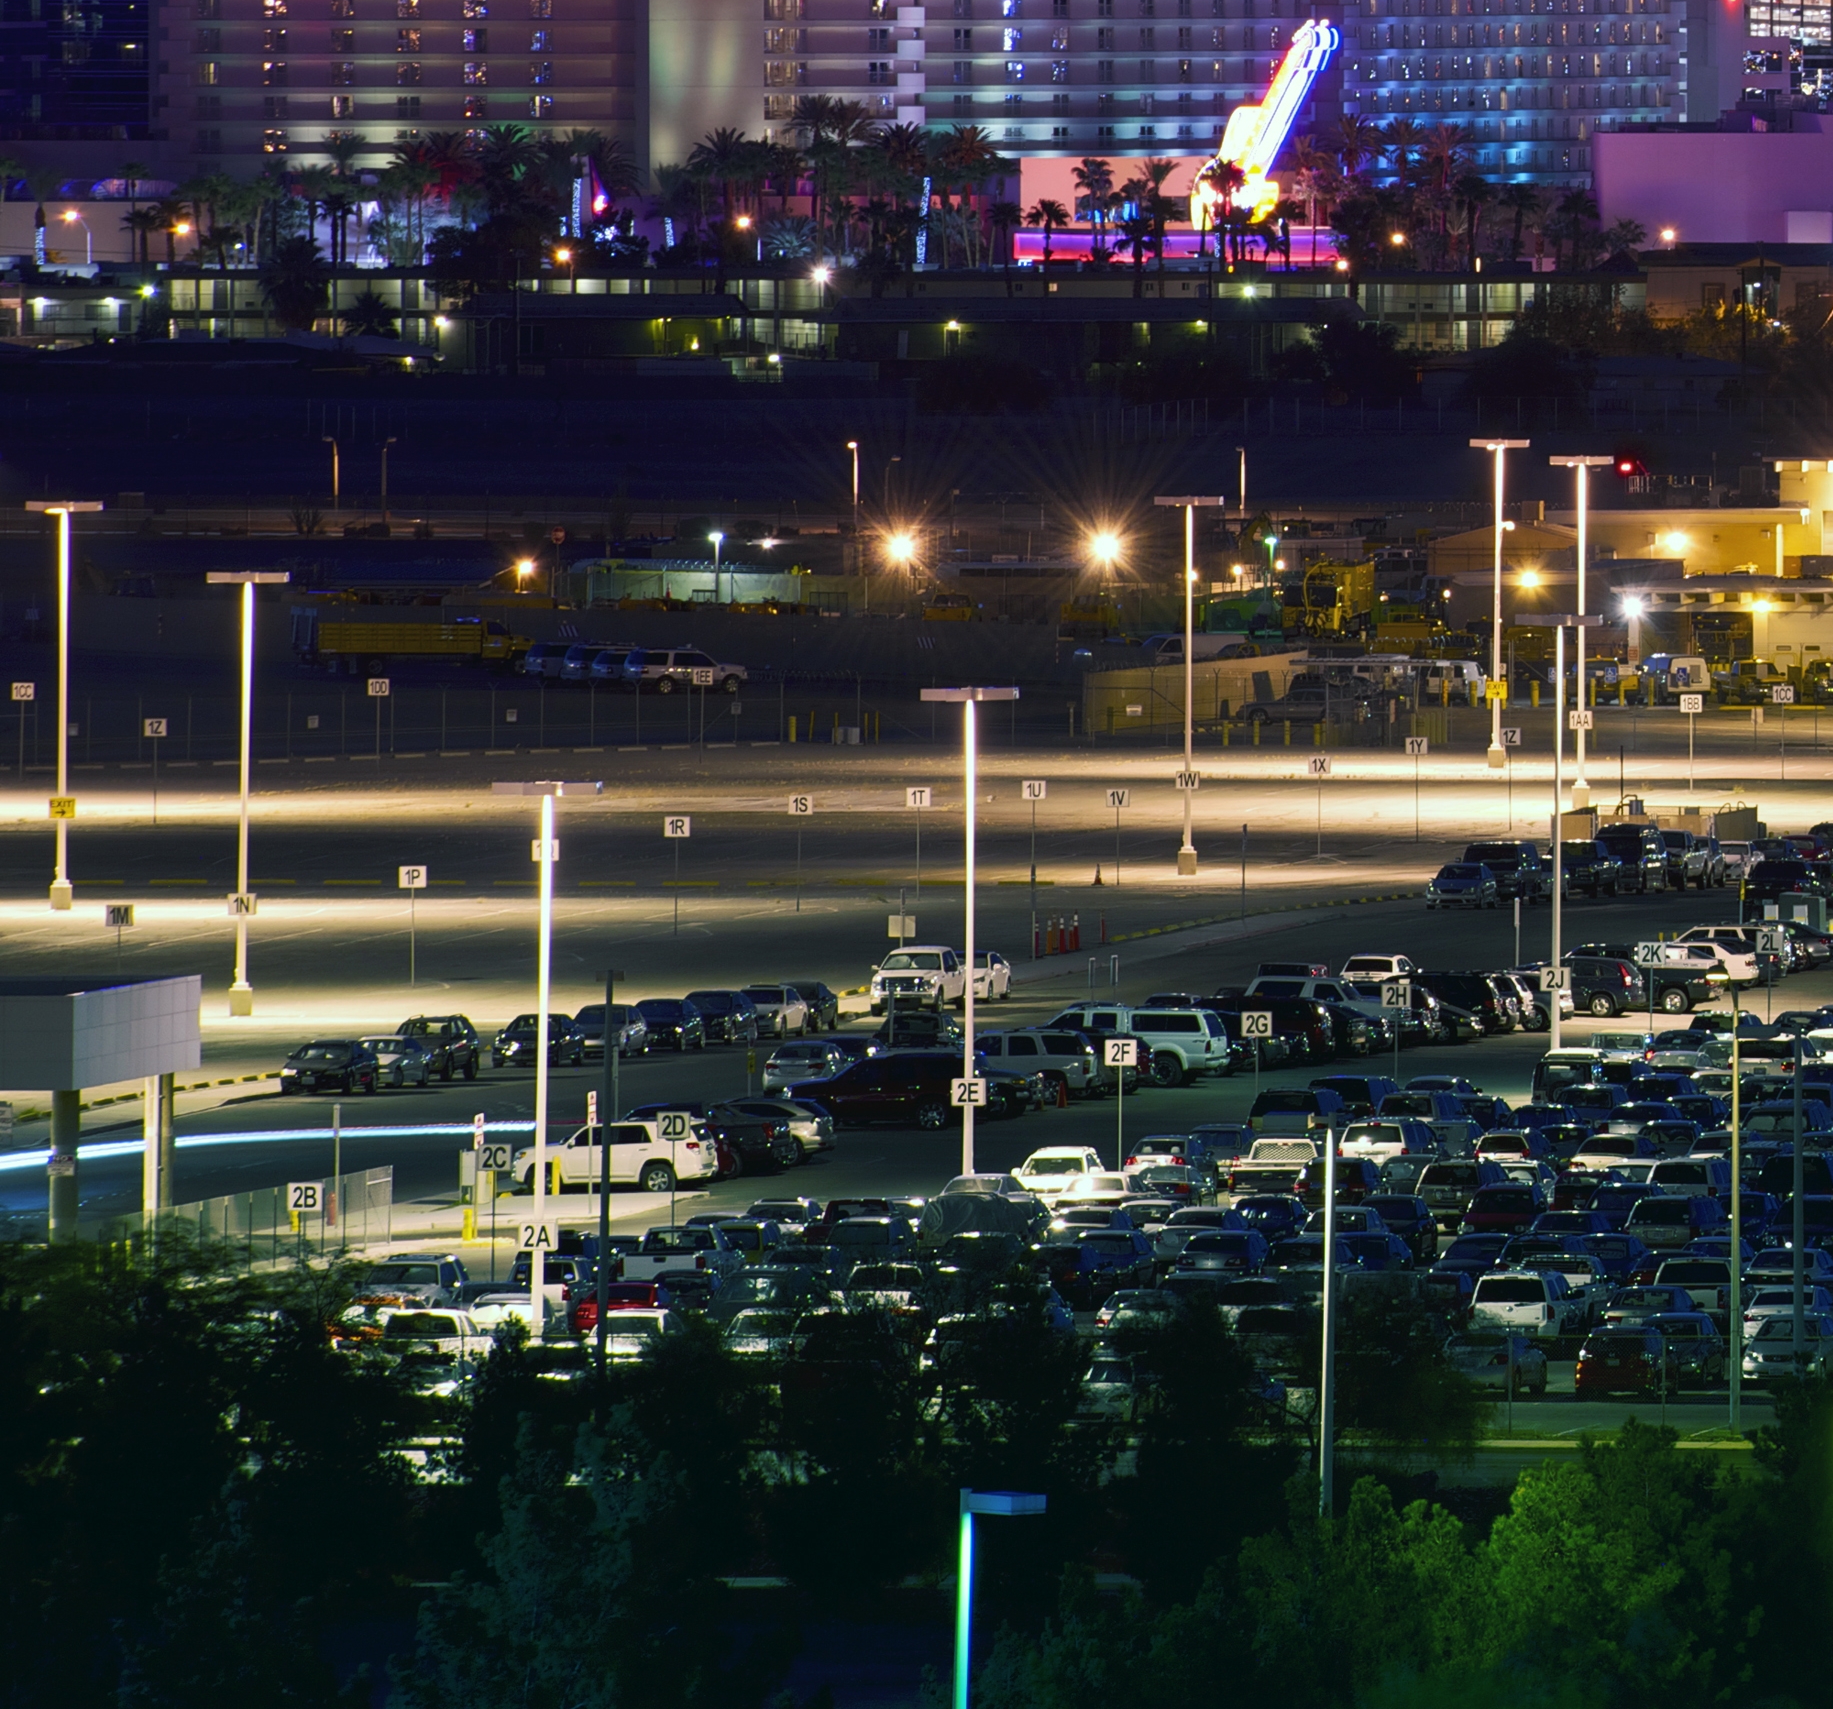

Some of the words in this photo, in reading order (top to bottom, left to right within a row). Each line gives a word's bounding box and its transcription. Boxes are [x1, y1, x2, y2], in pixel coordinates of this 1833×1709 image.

[695, 671, 711, 683] 1EE
[14, 684, 32, 698] 1CC
[370, 681, 387, 694] 1DD
[1775, 687, 1791, 701] 1CC
[1683, 697, 1700, 710] 1BB
[148, 720, 162, 735] 1Z
[1571, 714, 1589, 727] 1AA
[1503, 730, 1516, 744] 1Z
[1409, 739, 1423, 753] 1Y
[1312, 759, 1326, 772] 1X
[1178, 773, 1197, 787] 1W
[911, 790, 925, 805] 1T
[1027, 783, 1041, 798] 1U
[1110, 791, 1125, 805] 1V
[51, 800, 73, 808] EXIT
[793, 797, 808, 813] 1S
[669, 819, 685, 835] 1R
[405, 869, 420, 885] 1P
[233, 897, 250, 913] 1N
[109, 907, 129, 924] 1M
[1761, 933, 1779, 951] 2L
[1642, 945, 1662, 963] 2K
[1546, 970, 1564, 989] 2J
[1386, 986, 1407, 1005] 2H
[1246, 1014, 1268, 1034] 2G
[1111, 1043, 1131, 1062] 2F
[957, 1083, 979, 1103] 2E
[662, 1115, 685, 1136] 2D
[482, 1146, 506, 1169] 2C
[293, 1186, 317, 1208] 2B
[524, 1225, 551, 1247] 2A
